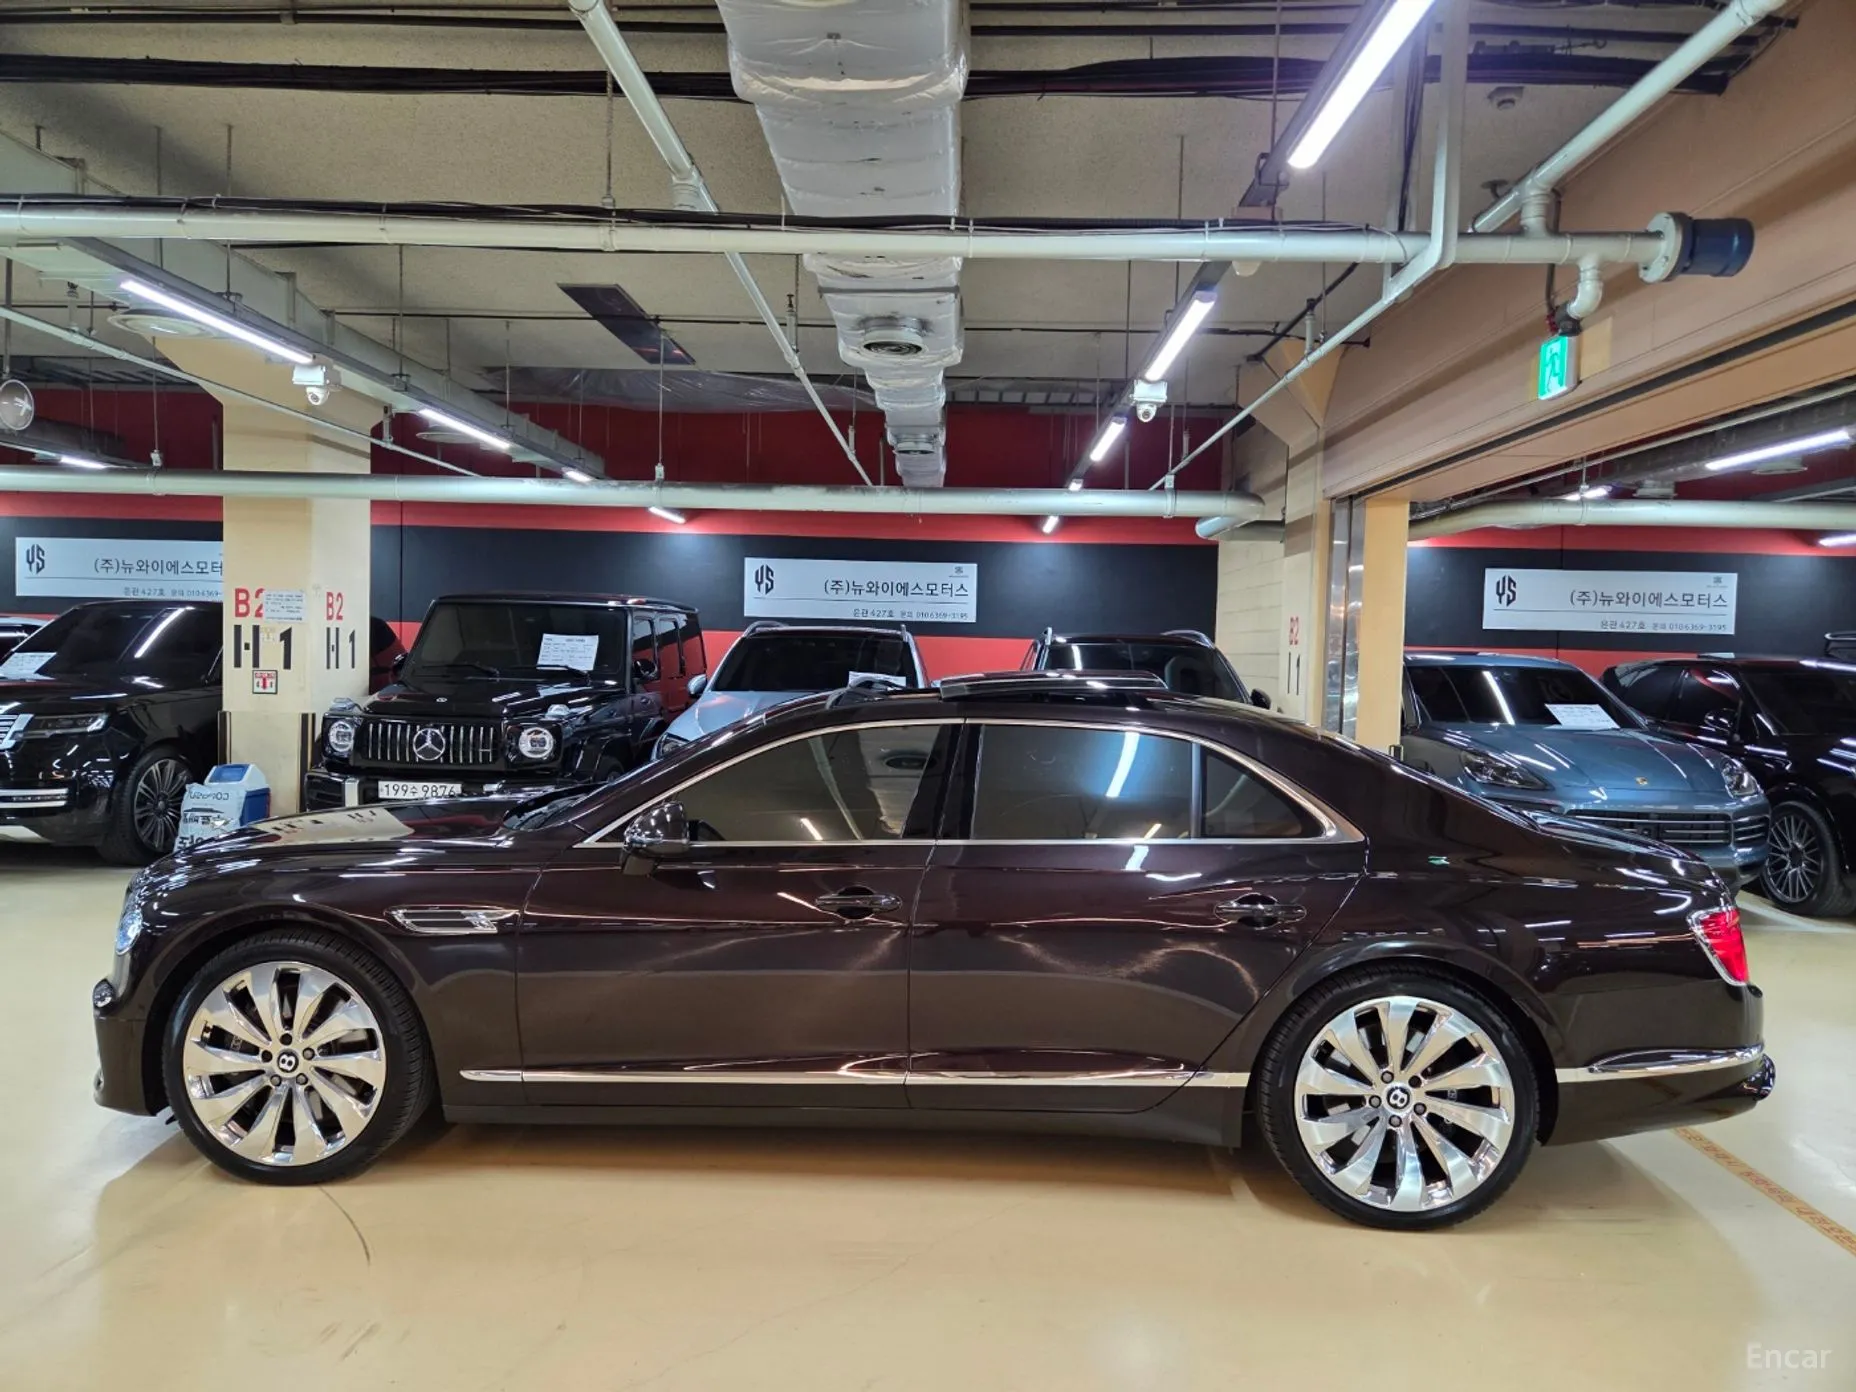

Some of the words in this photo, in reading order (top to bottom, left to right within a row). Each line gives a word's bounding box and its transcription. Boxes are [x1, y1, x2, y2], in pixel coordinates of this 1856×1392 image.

[94, 558, 223, 577] (주)뉴와이에스모터
[824, 579, 969, 597] (주)뉴와이에스모터스
[234, 587, 265, 618] B2
[326, 592, 344, 620] B2
[1570, 590, 1728, 608] (주)뉴와이에스모터스
